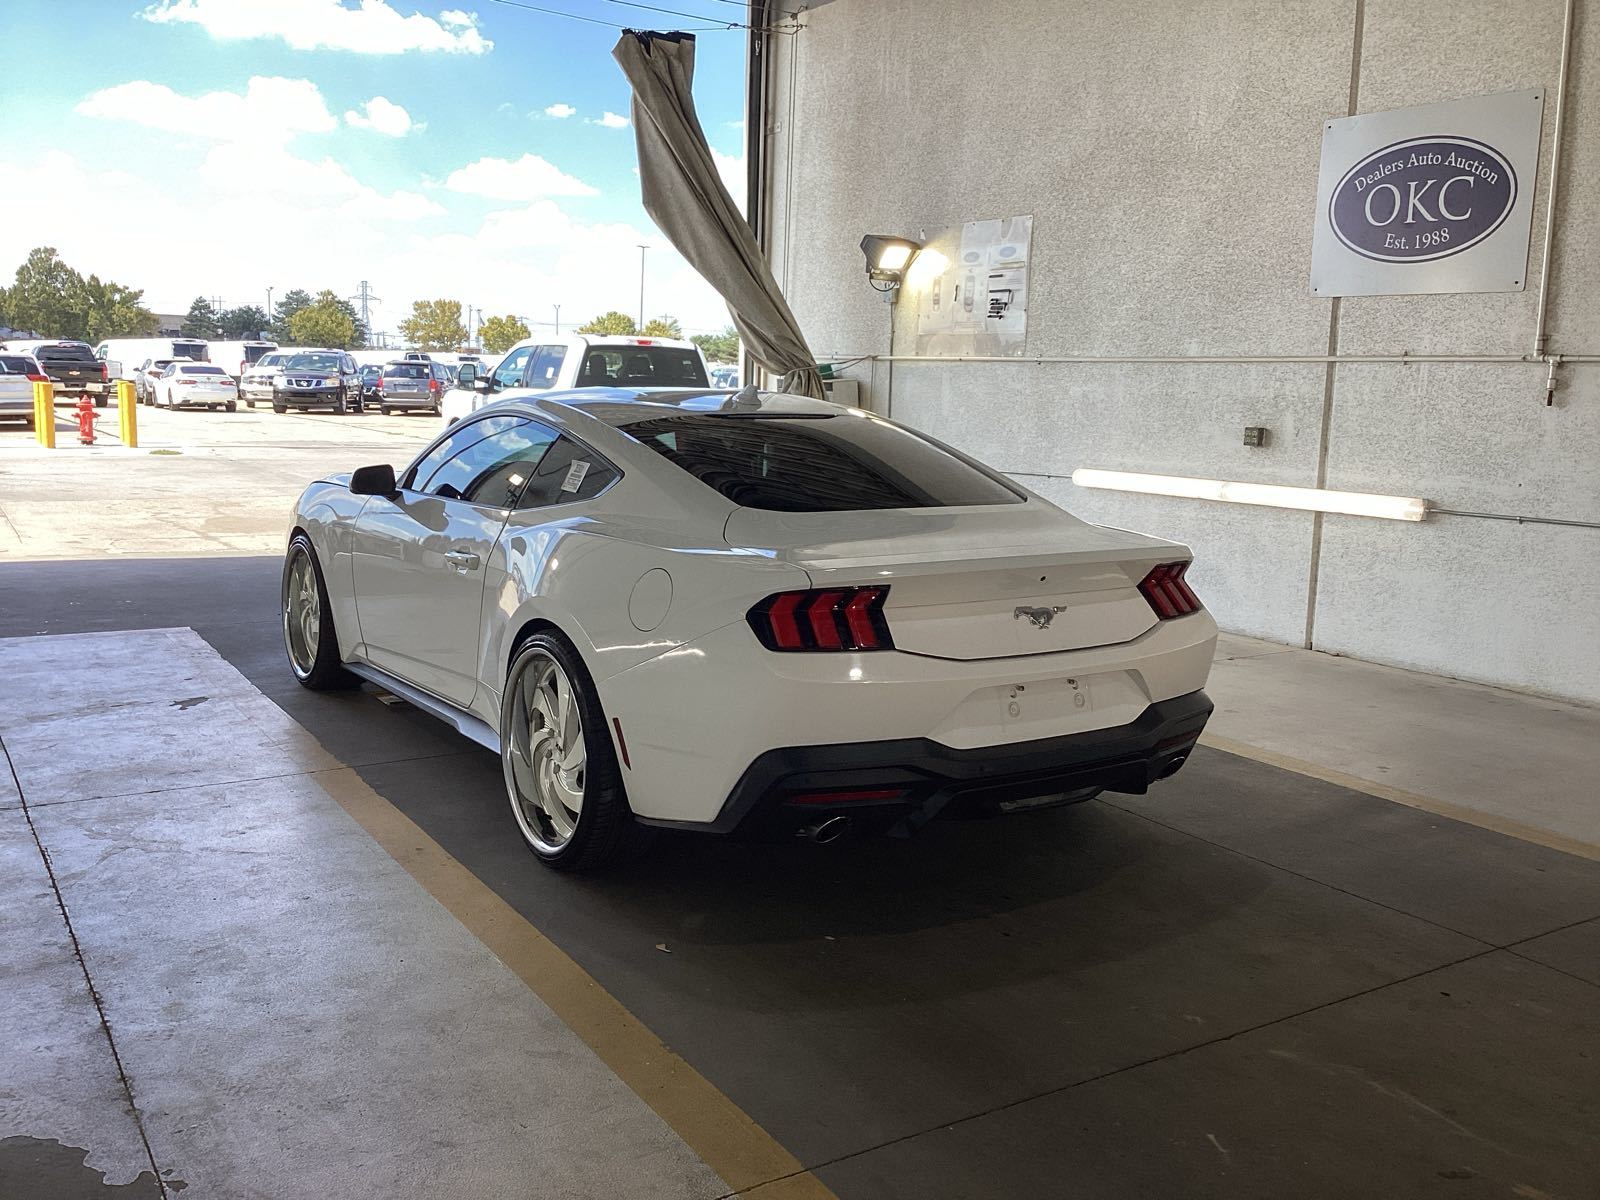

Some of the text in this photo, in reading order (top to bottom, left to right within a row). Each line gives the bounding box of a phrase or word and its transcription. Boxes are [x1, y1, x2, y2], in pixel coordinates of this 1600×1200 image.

[1353, 151, 1498, 192] Dealers Auto Auction
[1365, 176, 1475, 226] OKC
[1384, 228, 1450, 249] Est. 1988
